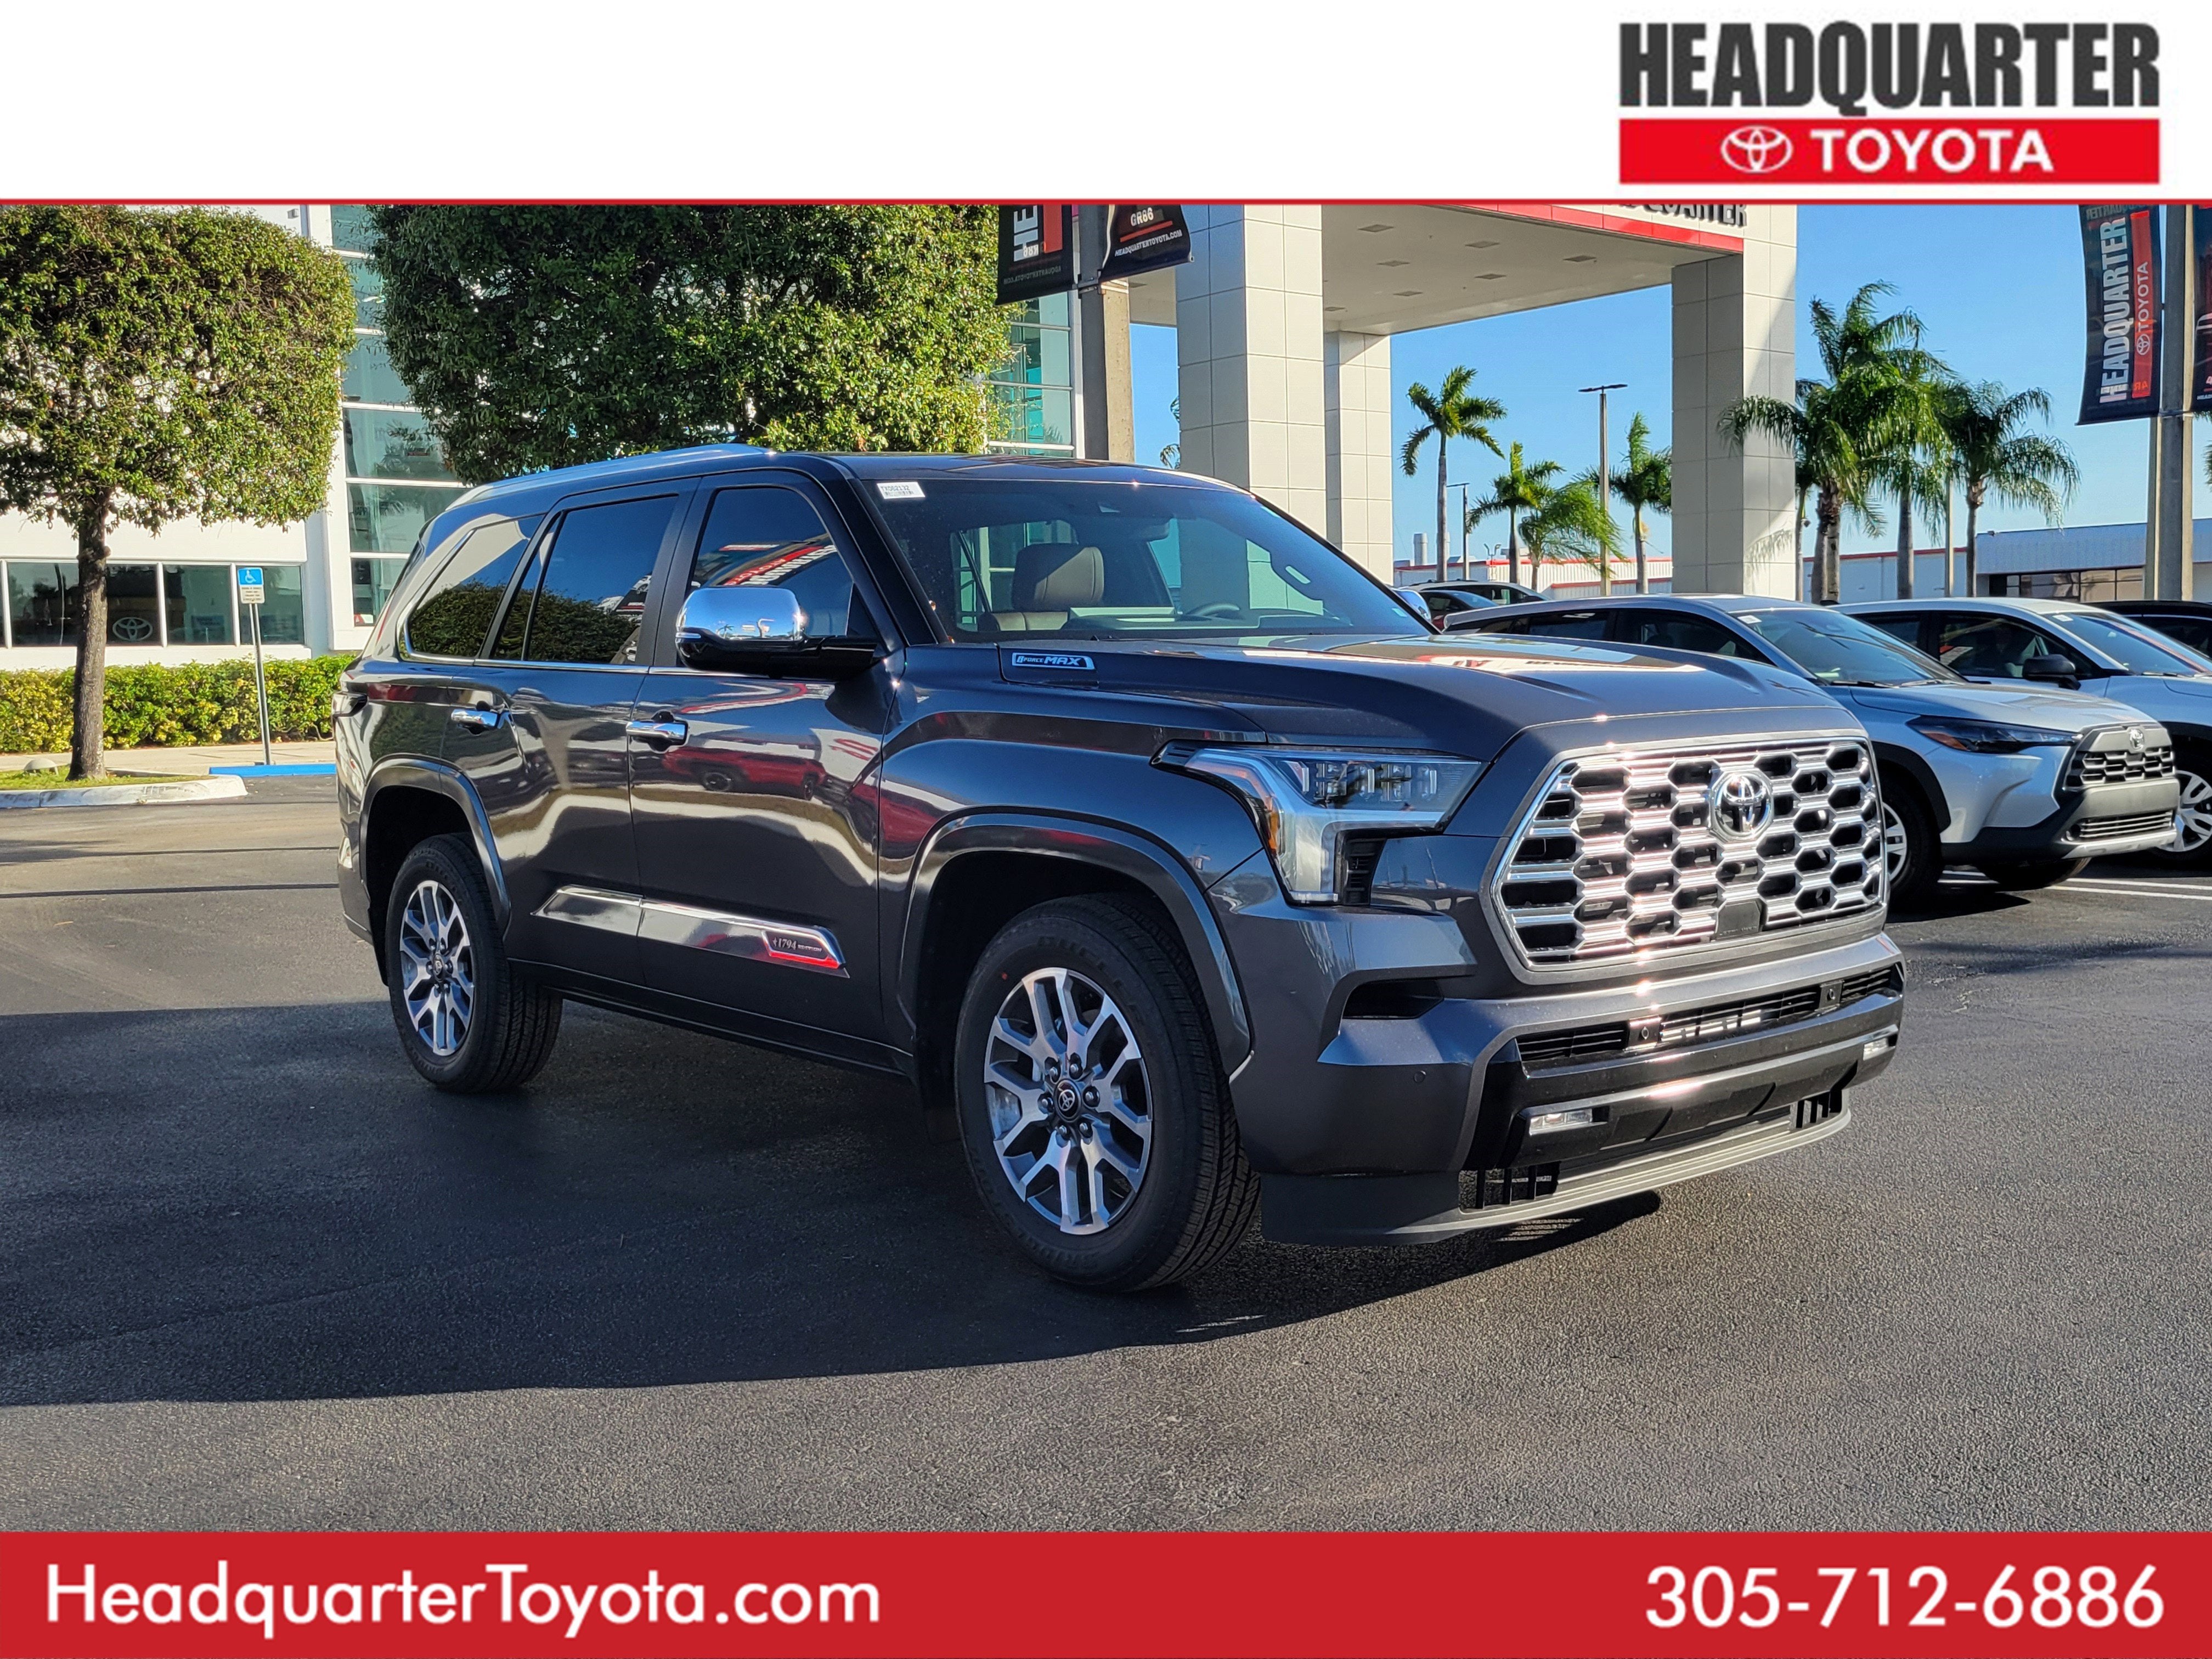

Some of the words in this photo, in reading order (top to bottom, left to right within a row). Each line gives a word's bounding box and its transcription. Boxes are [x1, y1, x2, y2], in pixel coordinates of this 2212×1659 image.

[1130, 207, 1154, 226] GR86
[2137, 262, 2149, 332] TOYOTA
[2099, 216, 2134, 403] HEADQUARTER
[1044, 656, 1082, 666] MAX
[778, 938, 797, 950] 1794
